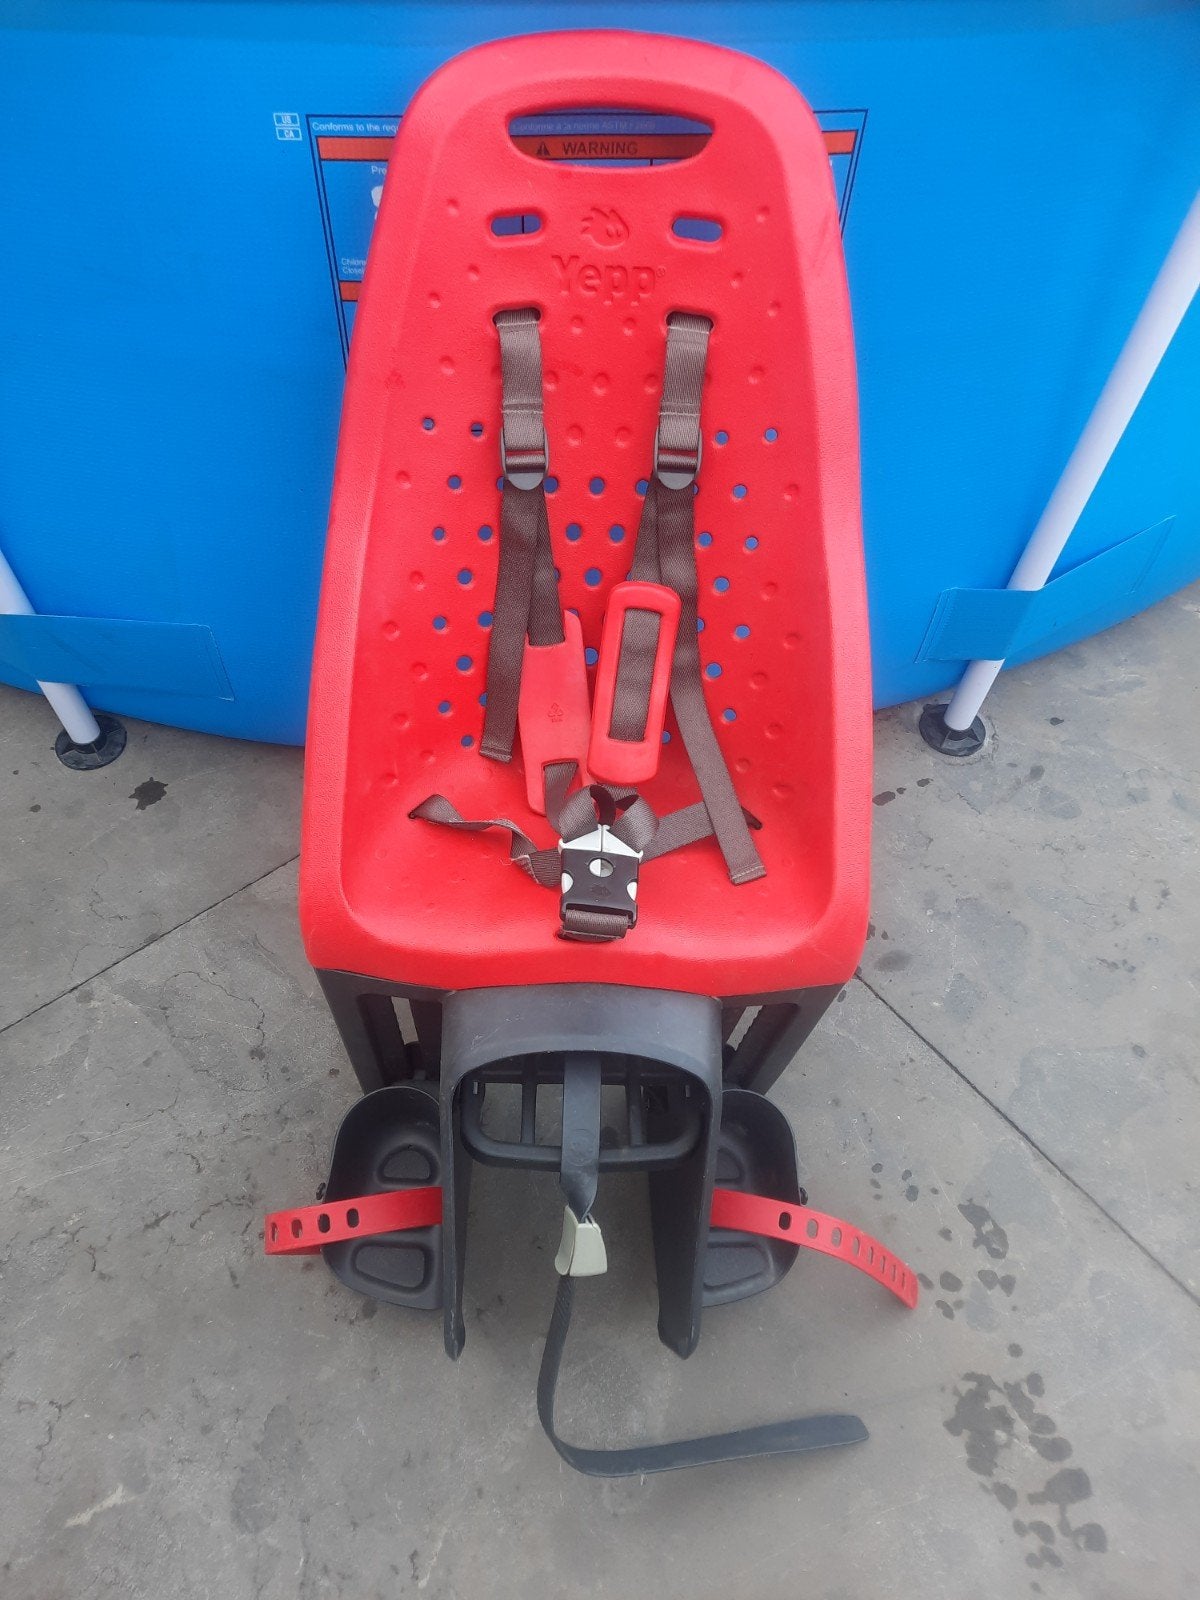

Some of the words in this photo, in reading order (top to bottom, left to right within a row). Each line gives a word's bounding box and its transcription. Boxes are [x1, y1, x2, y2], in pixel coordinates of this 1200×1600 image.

[281, 115, 292, 124] US
[312, 121, 354, 131] Conforms
[356, 122, 364, 132] to
[366, 122, 380, 132] the
[284, 129, 295, 138] CA
[563, 141, 638, 155] WARNING
